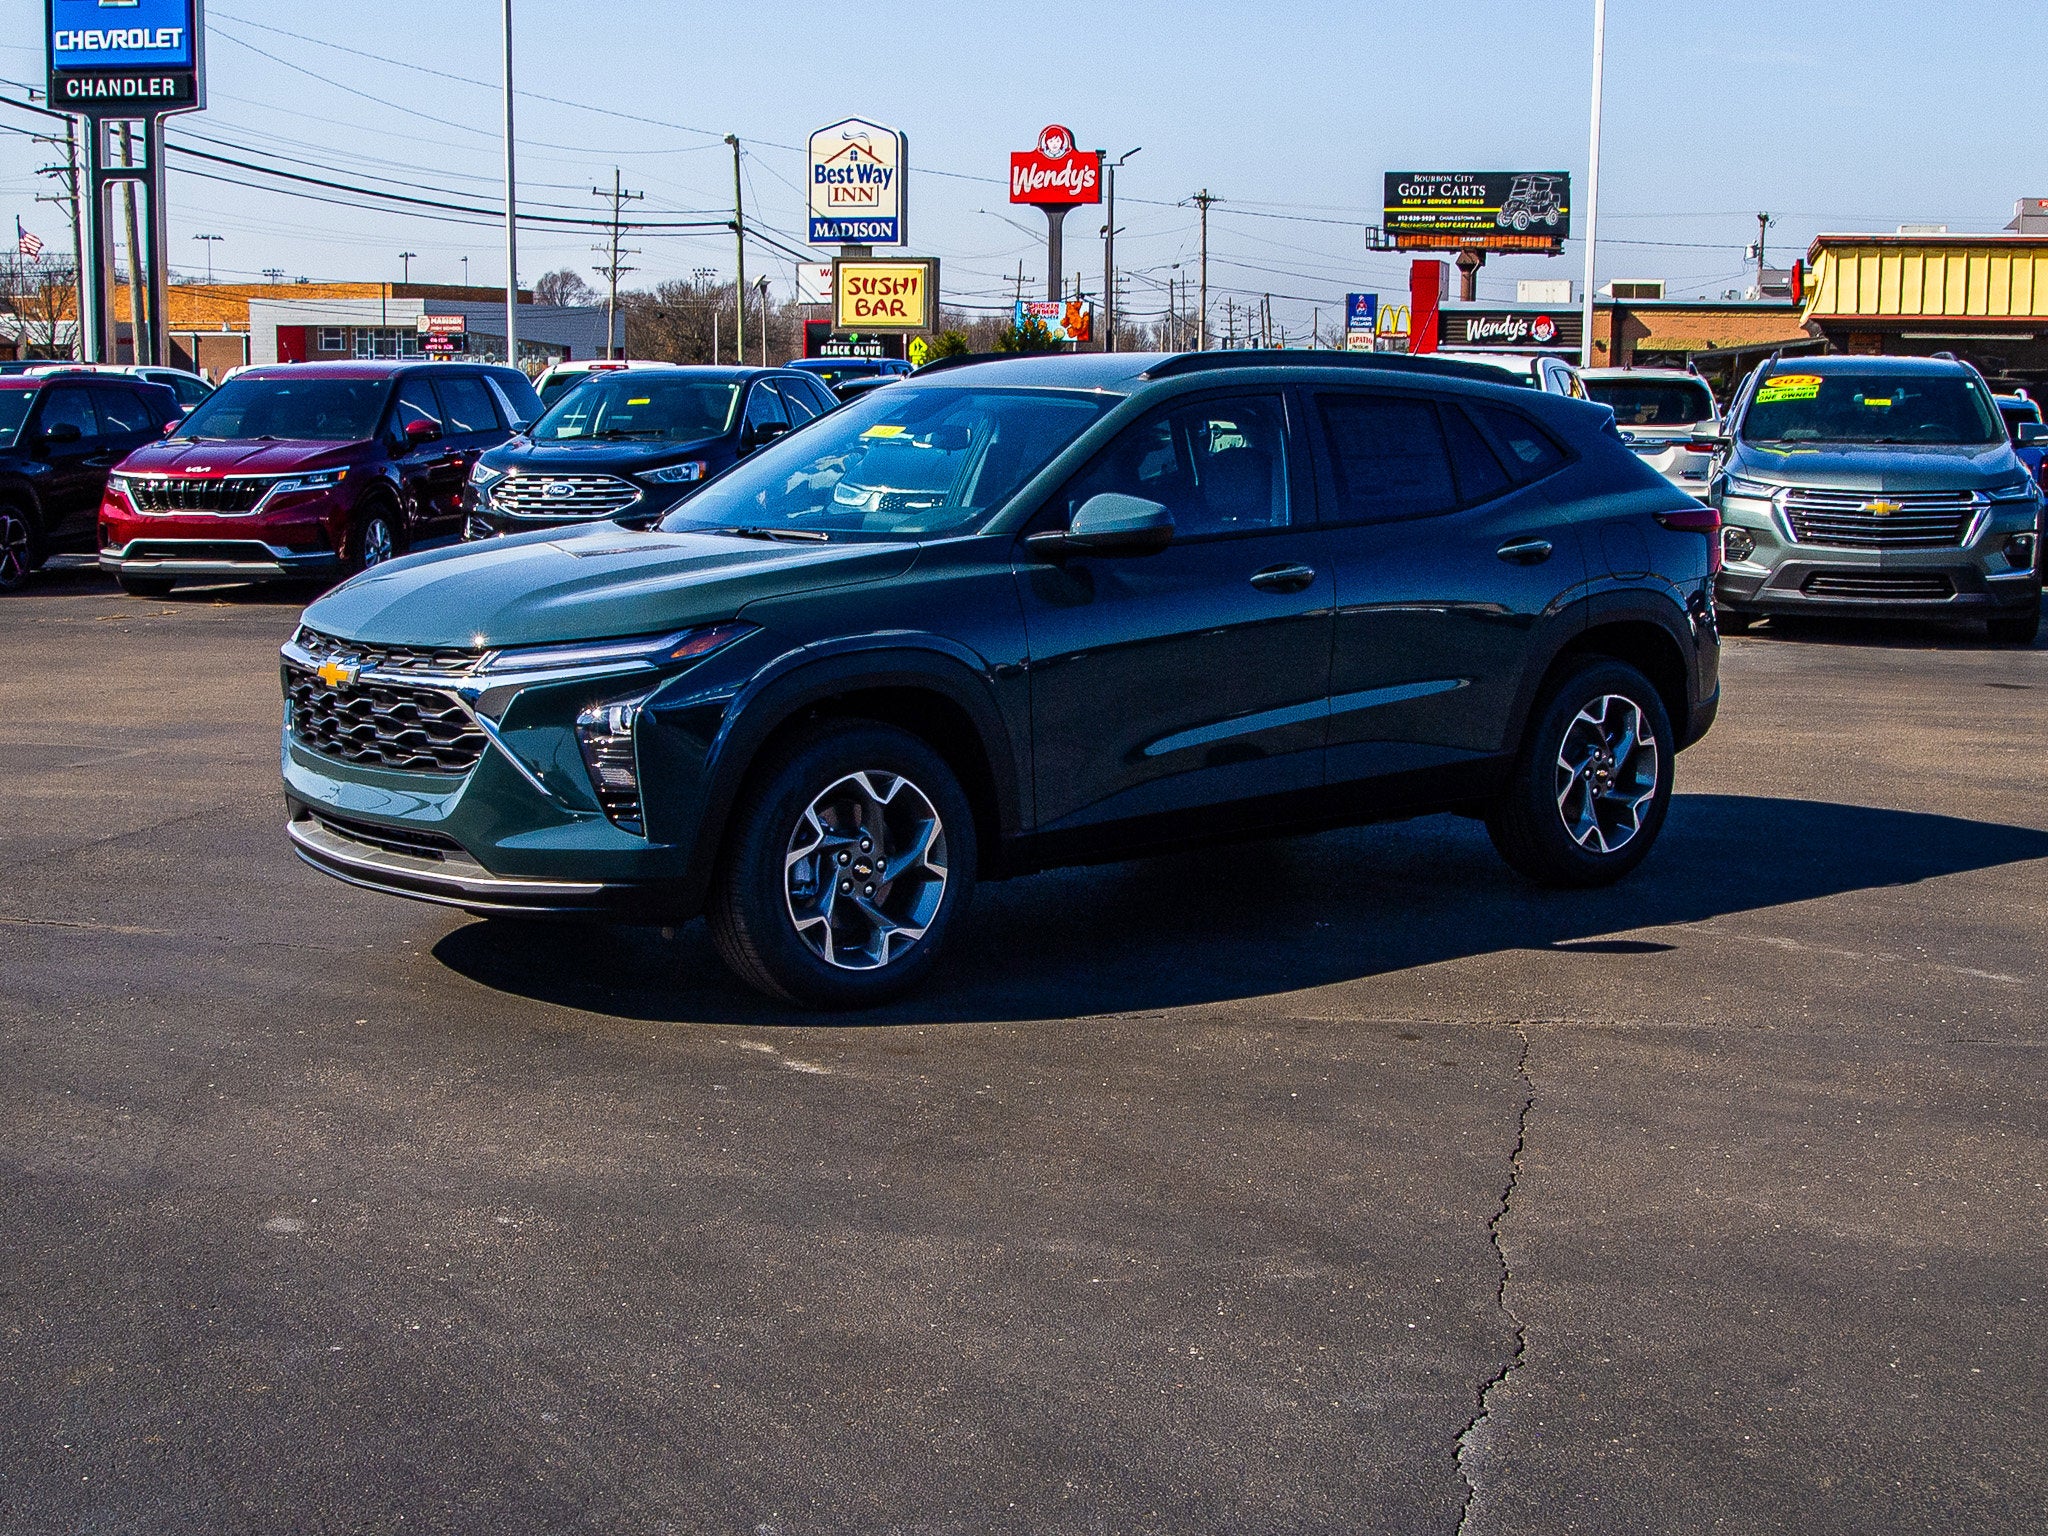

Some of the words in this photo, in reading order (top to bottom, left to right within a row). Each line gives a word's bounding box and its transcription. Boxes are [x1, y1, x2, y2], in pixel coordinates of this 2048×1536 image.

[55, 28, 183, 50] CHEVROLET
[66, 78, 175, 97] CHANDLER
[814, 164, 854, 184] Best
[855, 163, 893, 190] Way
[1012, 158, 1096, 196] Wendy's
[1413, 174, 1452, 183] BOURBON
[1454, 174, 1474, 183] CITY
[832, 187, 874, 202] INN
[1398, 183, 1435, 196] GOLF
[1440, 183, 1486, 196] CARTS
[813, 222, 893, 237] MADISON
[847, 276, 918, 296] SUSHI
[855, 298, 908, 317] BAR
[430, 317, 462, 325] MADISON
[1466, 314, 1528, 342] Wendy's
[820, 345, 851, 356] BLACK
[853, 345, 881, 356] OLIVE
[1758, 393, 1777, 401] ONE
[1781, 391, 1815, 399] OWNER
